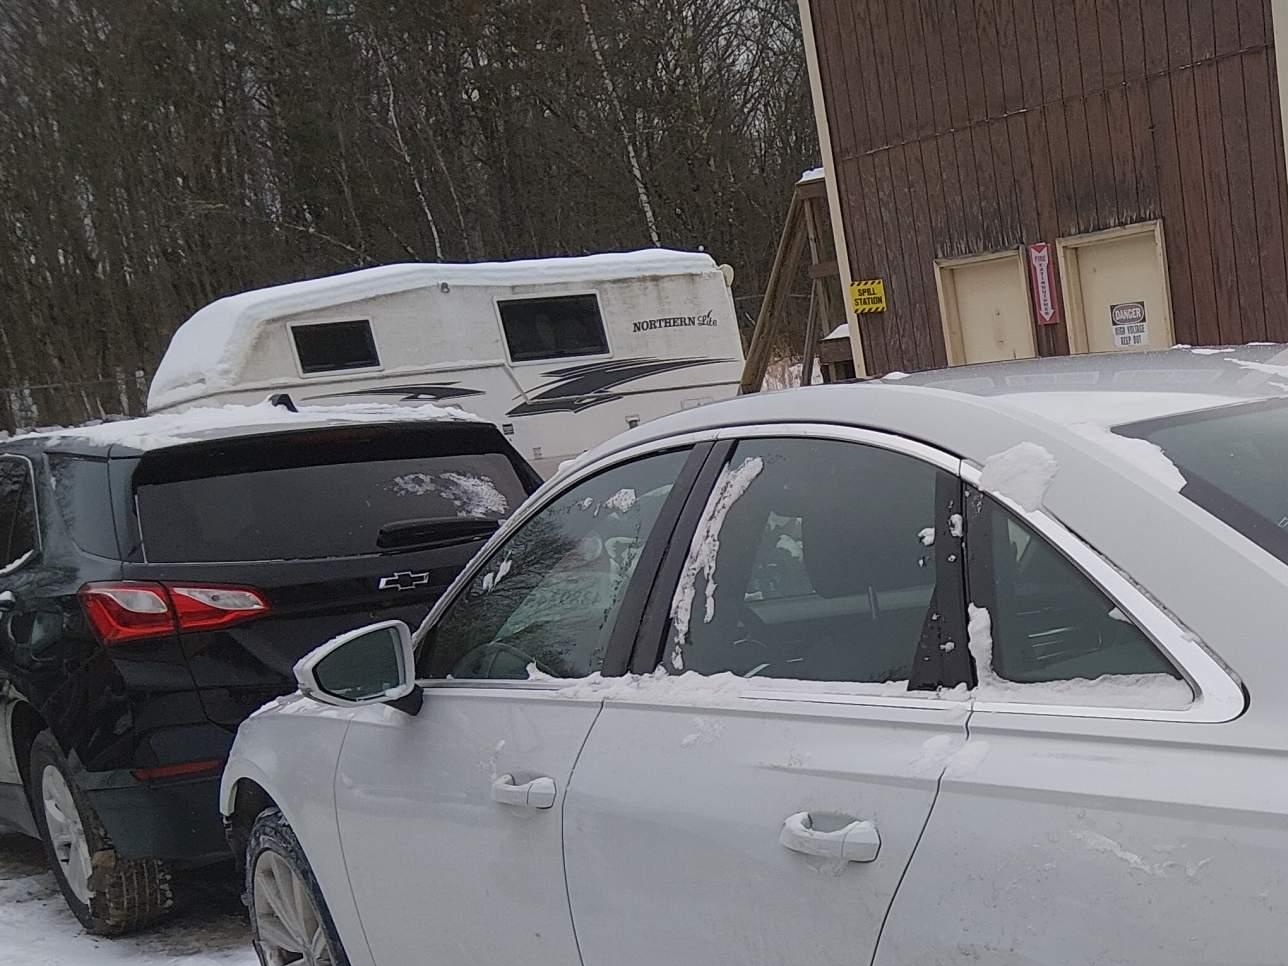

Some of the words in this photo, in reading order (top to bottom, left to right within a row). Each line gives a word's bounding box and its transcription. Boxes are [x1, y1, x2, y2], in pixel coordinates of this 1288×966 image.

[857, 287, 876, 297] SPILL
[854, 296, 883, 307] STATION
[1115, 307, 1142, 321] DANGER
[632, 316, 696, 333] NORTHERN
